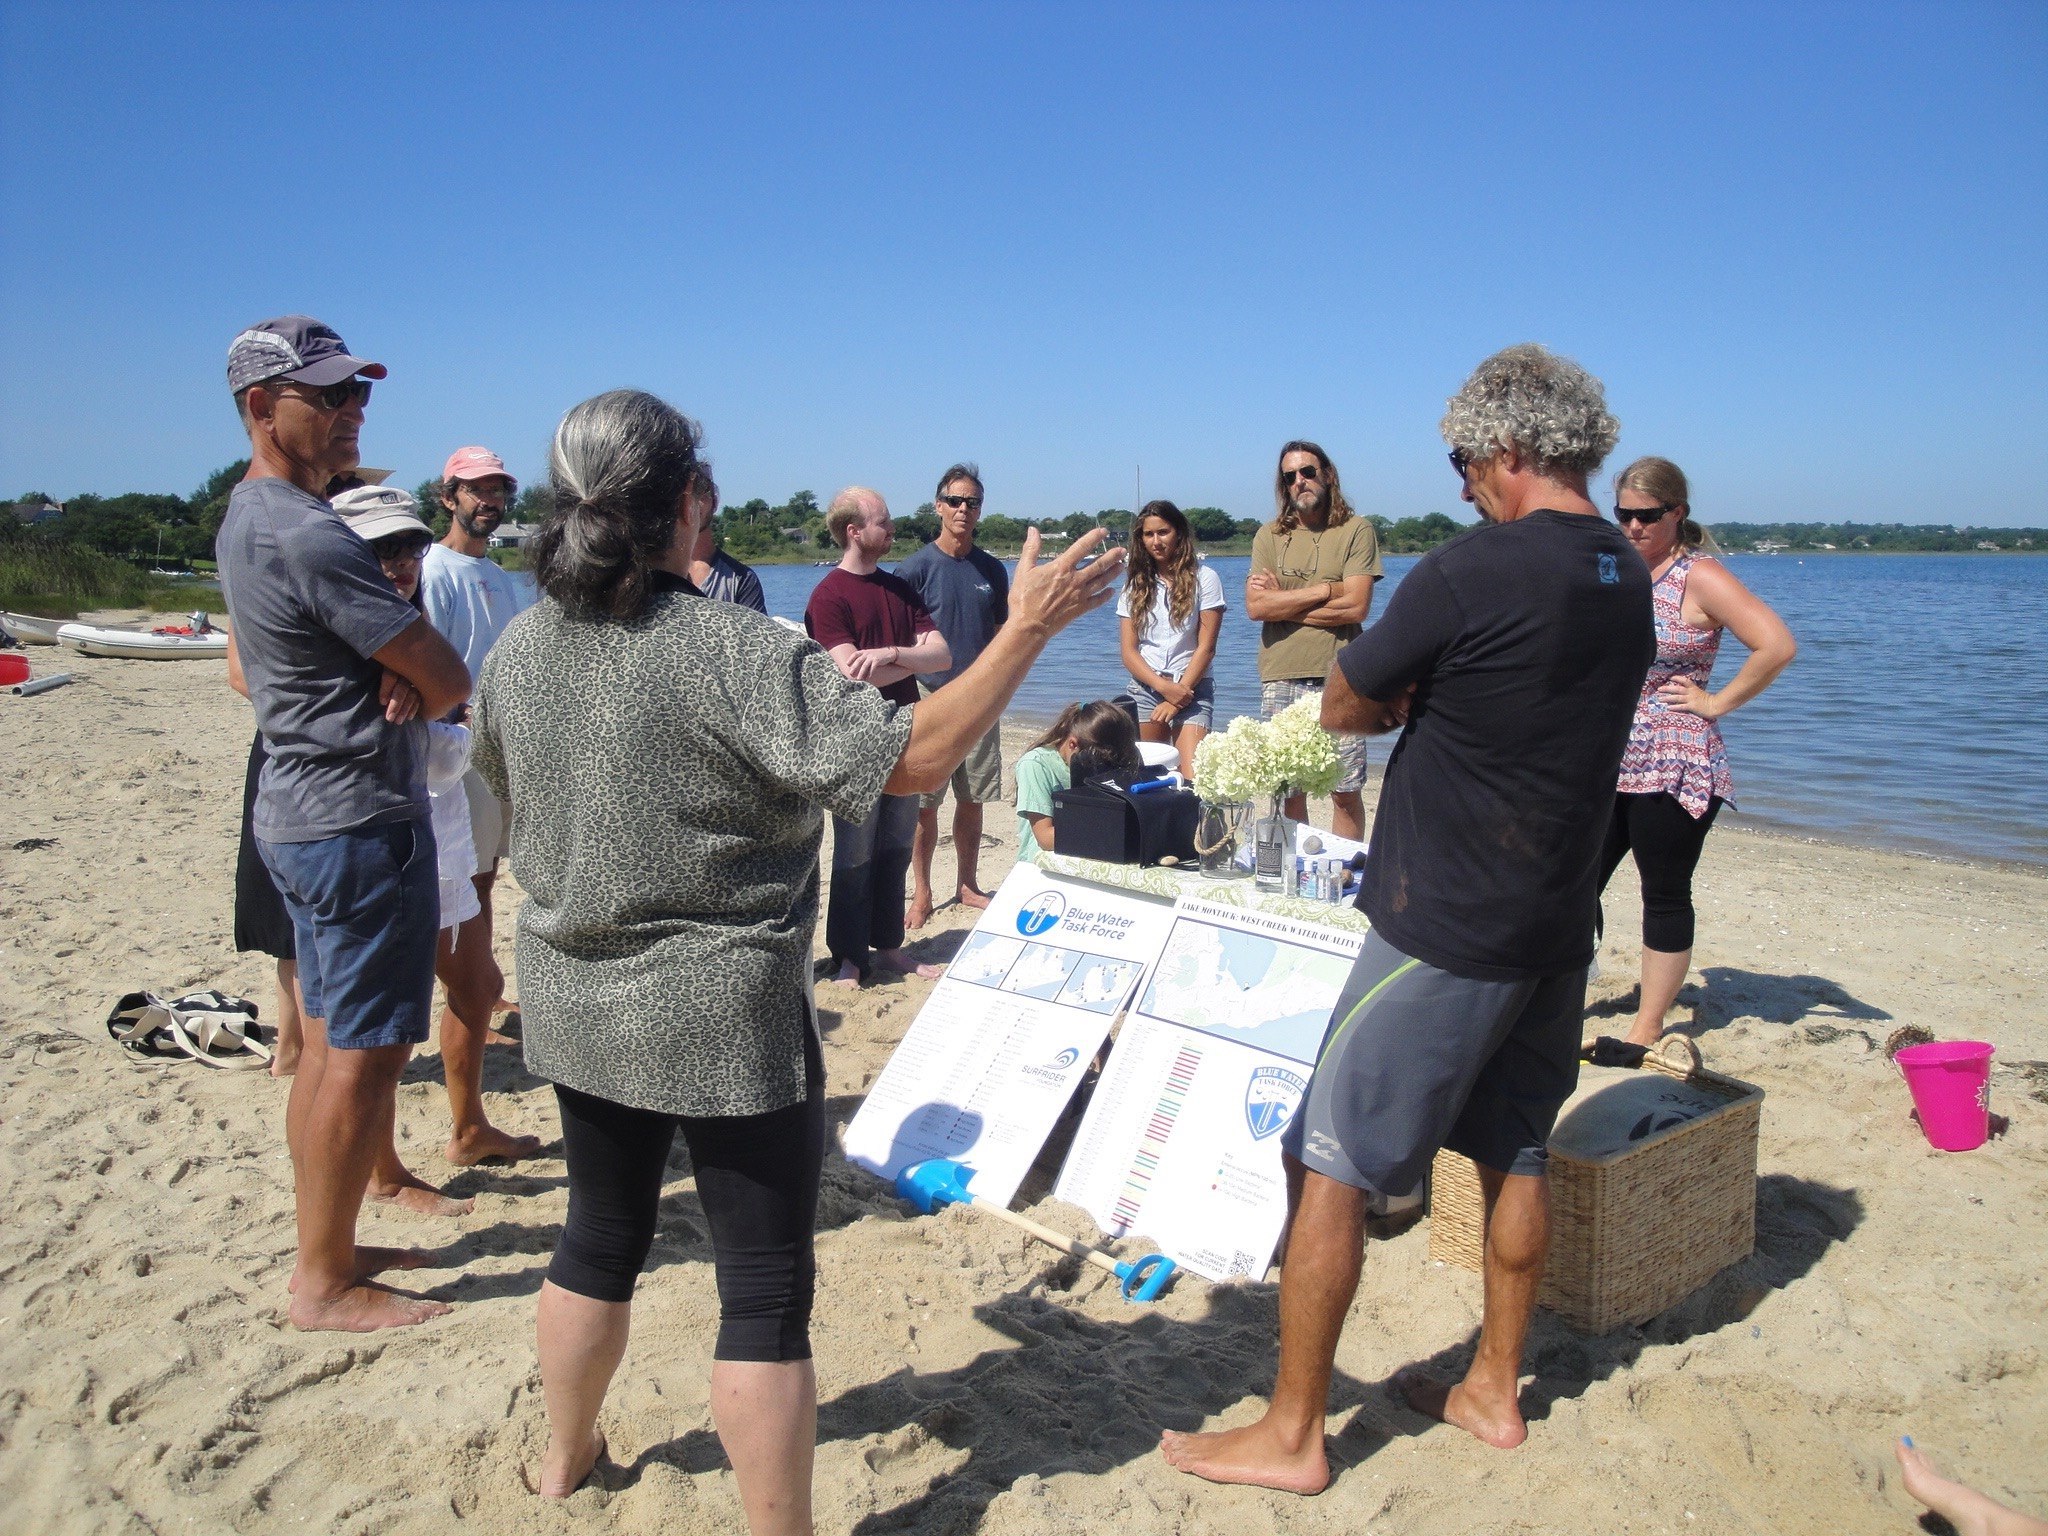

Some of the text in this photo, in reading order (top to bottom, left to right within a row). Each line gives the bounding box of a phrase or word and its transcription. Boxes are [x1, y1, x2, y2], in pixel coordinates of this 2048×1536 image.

[1067, 907, 1135, 928] Blue Water
[1181, 902, 1201, 912] LAKE
[1202, 906, 1239, 921] MONTAUK:
[1240, 914, 1262, 926] WEST
[1262, 919, 1288, 932] CREEK
[1290, 924, 1318, 940] WATER
[1319, 932, 1357, 949] QUALITY
[1061, 919, 1126, 940] Task Force
[1021, 1065, 1066, 1083] SURFRIDER
[1257, 1068, 1280, 1077] BLUE
[1277, 1081, 1298, 1095] FORCE
[1202, 1249, 1227, 1263] SCAN CODE
[1204, 1256, 1225, 1268] CURRENT
